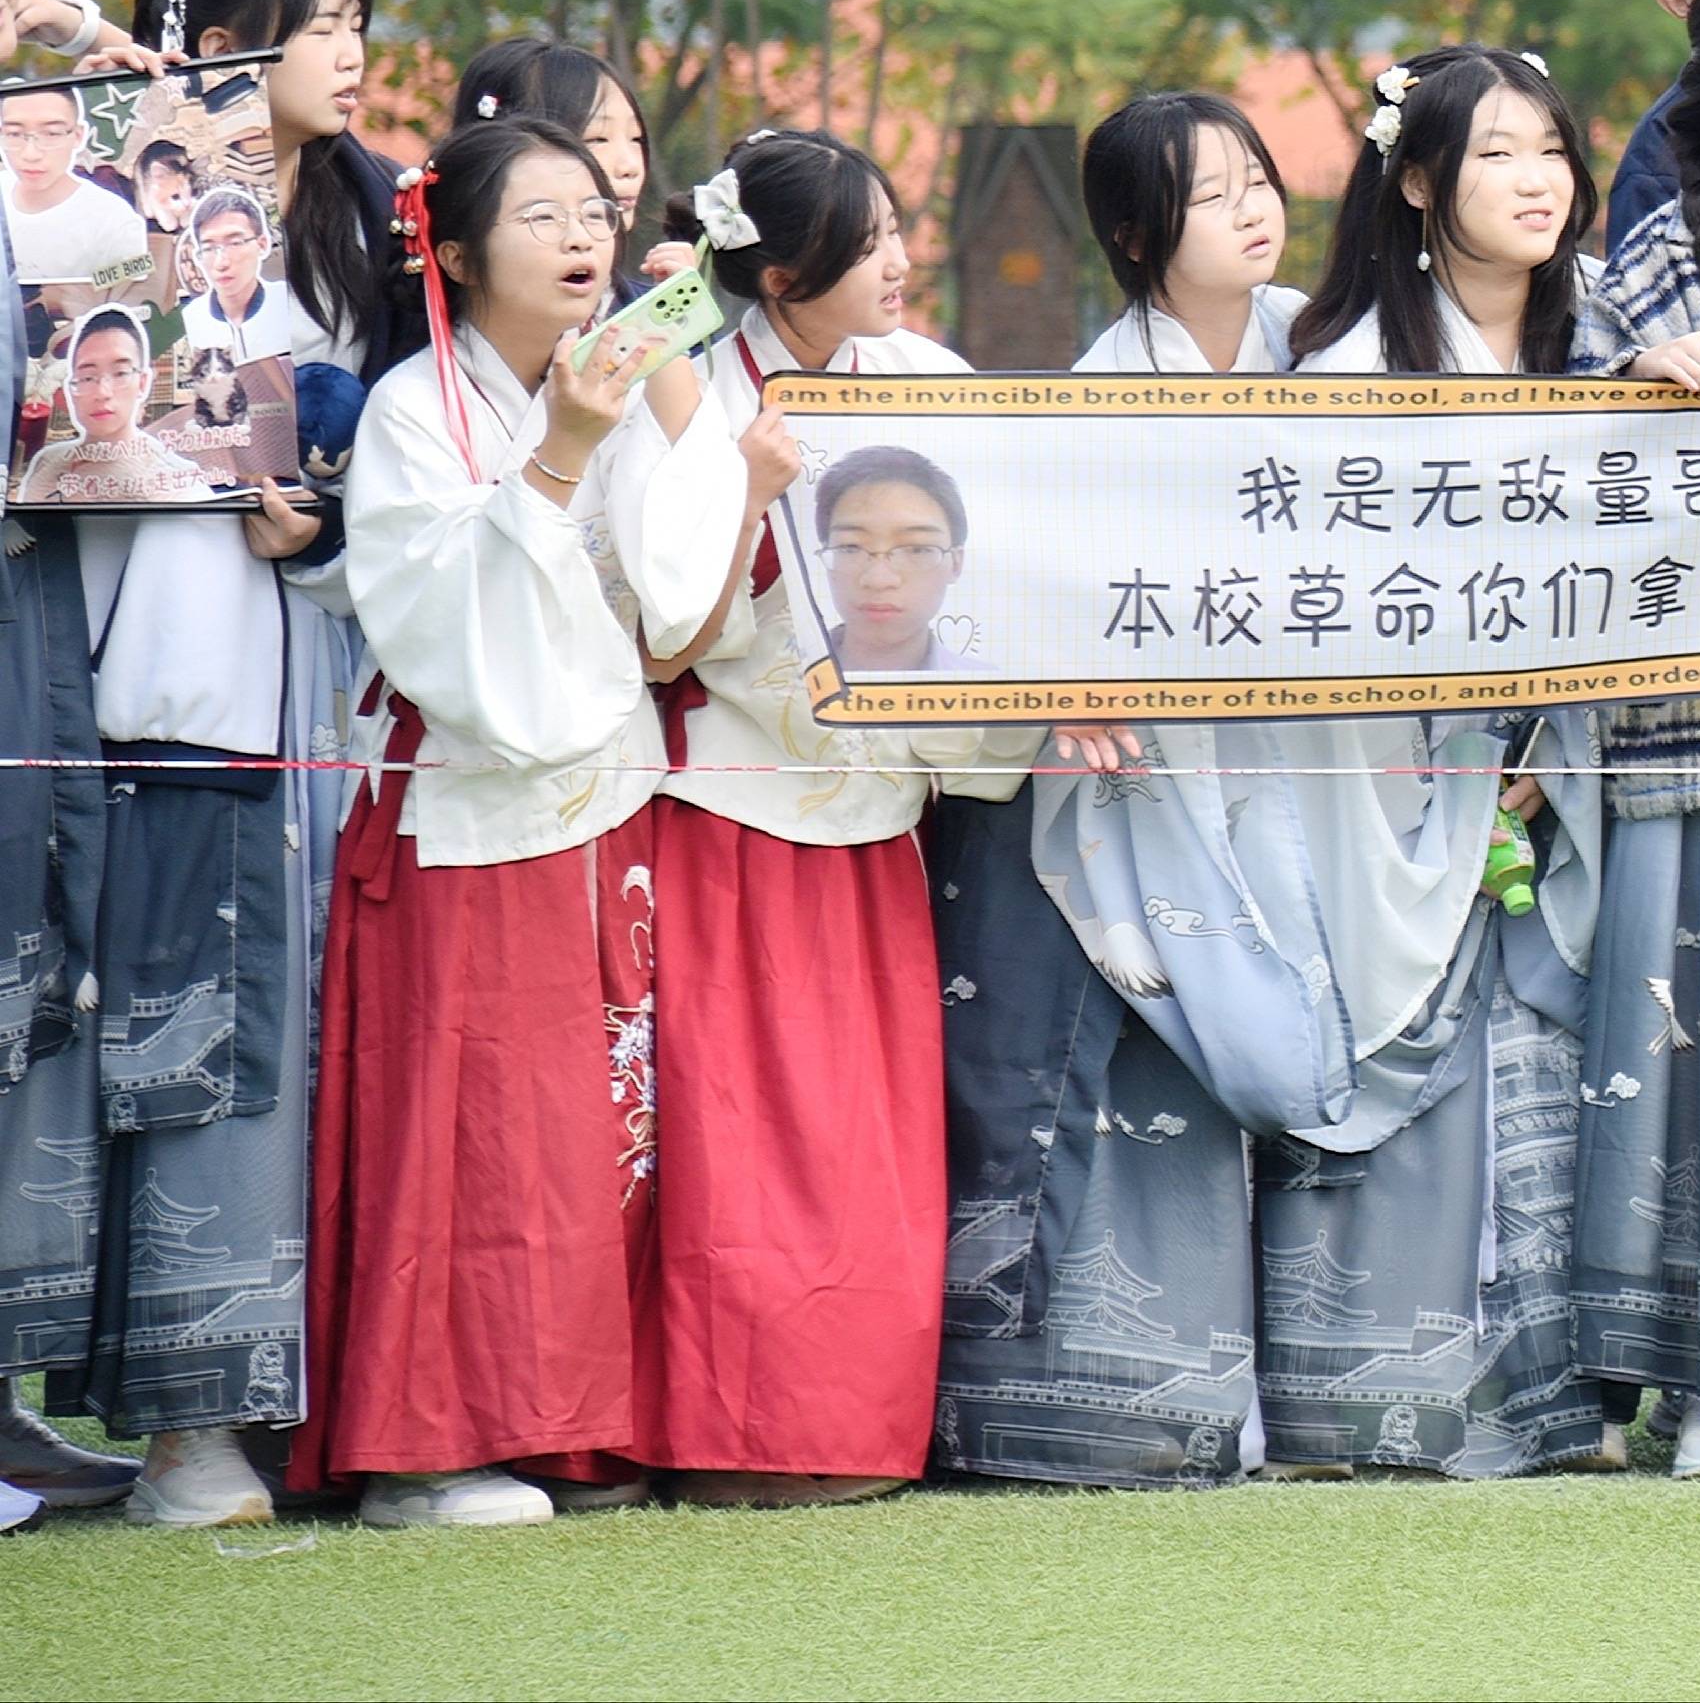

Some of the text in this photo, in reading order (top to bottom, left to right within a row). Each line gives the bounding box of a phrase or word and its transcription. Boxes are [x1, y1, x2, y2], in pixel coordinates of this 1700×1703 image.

[92, 268, 118, 287] LOVE
[778, 389, 827, 403] am
[838, 388, 894, 404] the
[904, 387, 1072, 405] invincible
[1084, 387, 1212, 405] brother
[1222, 387, 1254, 405] of
[1264, 387, 1318, 405] the
[1328, 387, 1449, 407] school,
[1459, 387, 1520, 404] and
[1530, 387, 1537, 403] I
[1548, 387, 1626, 403] have
[842, 694, 895, 712] the
[906, 692, 1074, 712] invincible
[1085, 689, 1213, 710] brother
[1223, 689, 1255, 707] of
[1264, 688, 1318, 706] the
[1328, 684, 1449, 704] school,
[1458, 681, 1517, 699] and
[1528, 680, 1535, 696] I
[1544, 673, 1617, 694] have
